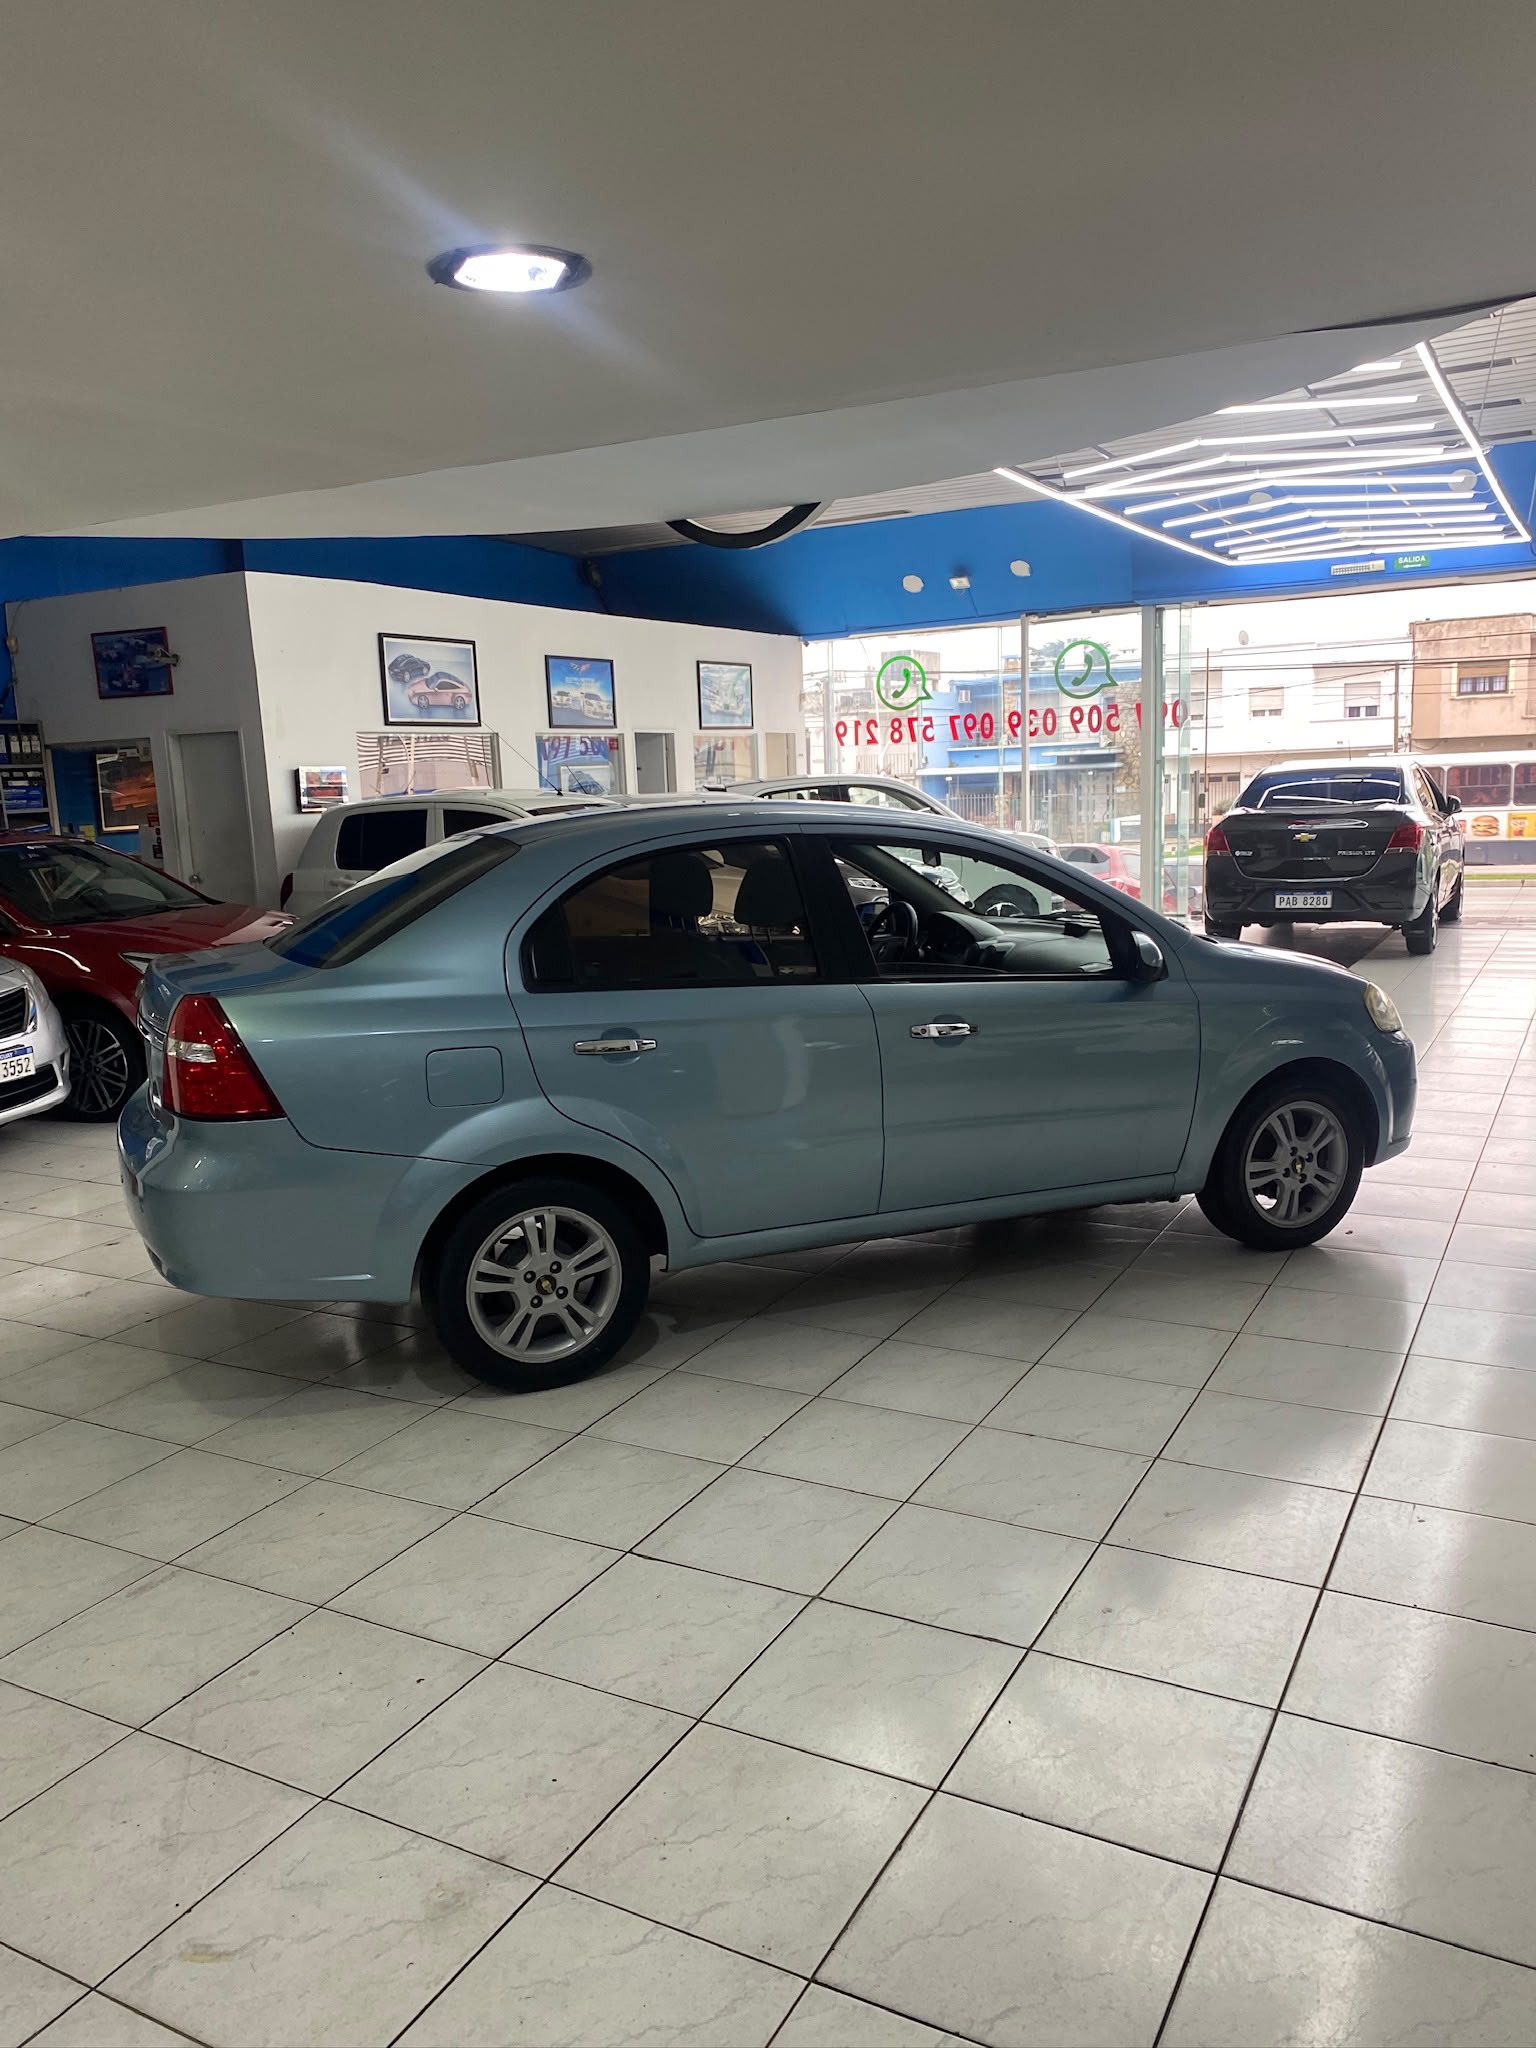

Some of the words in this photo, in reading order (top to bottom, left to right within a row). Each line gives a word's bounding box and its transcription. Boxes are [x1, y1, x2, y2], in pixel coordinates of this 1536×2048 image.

[1398, 555, 1426, 564] SALIDA
[1279, 896, 1298, 906] PAB
[1302, 896, 1328, 906] 8280
[1, 1057, 31, 1078] 3552
